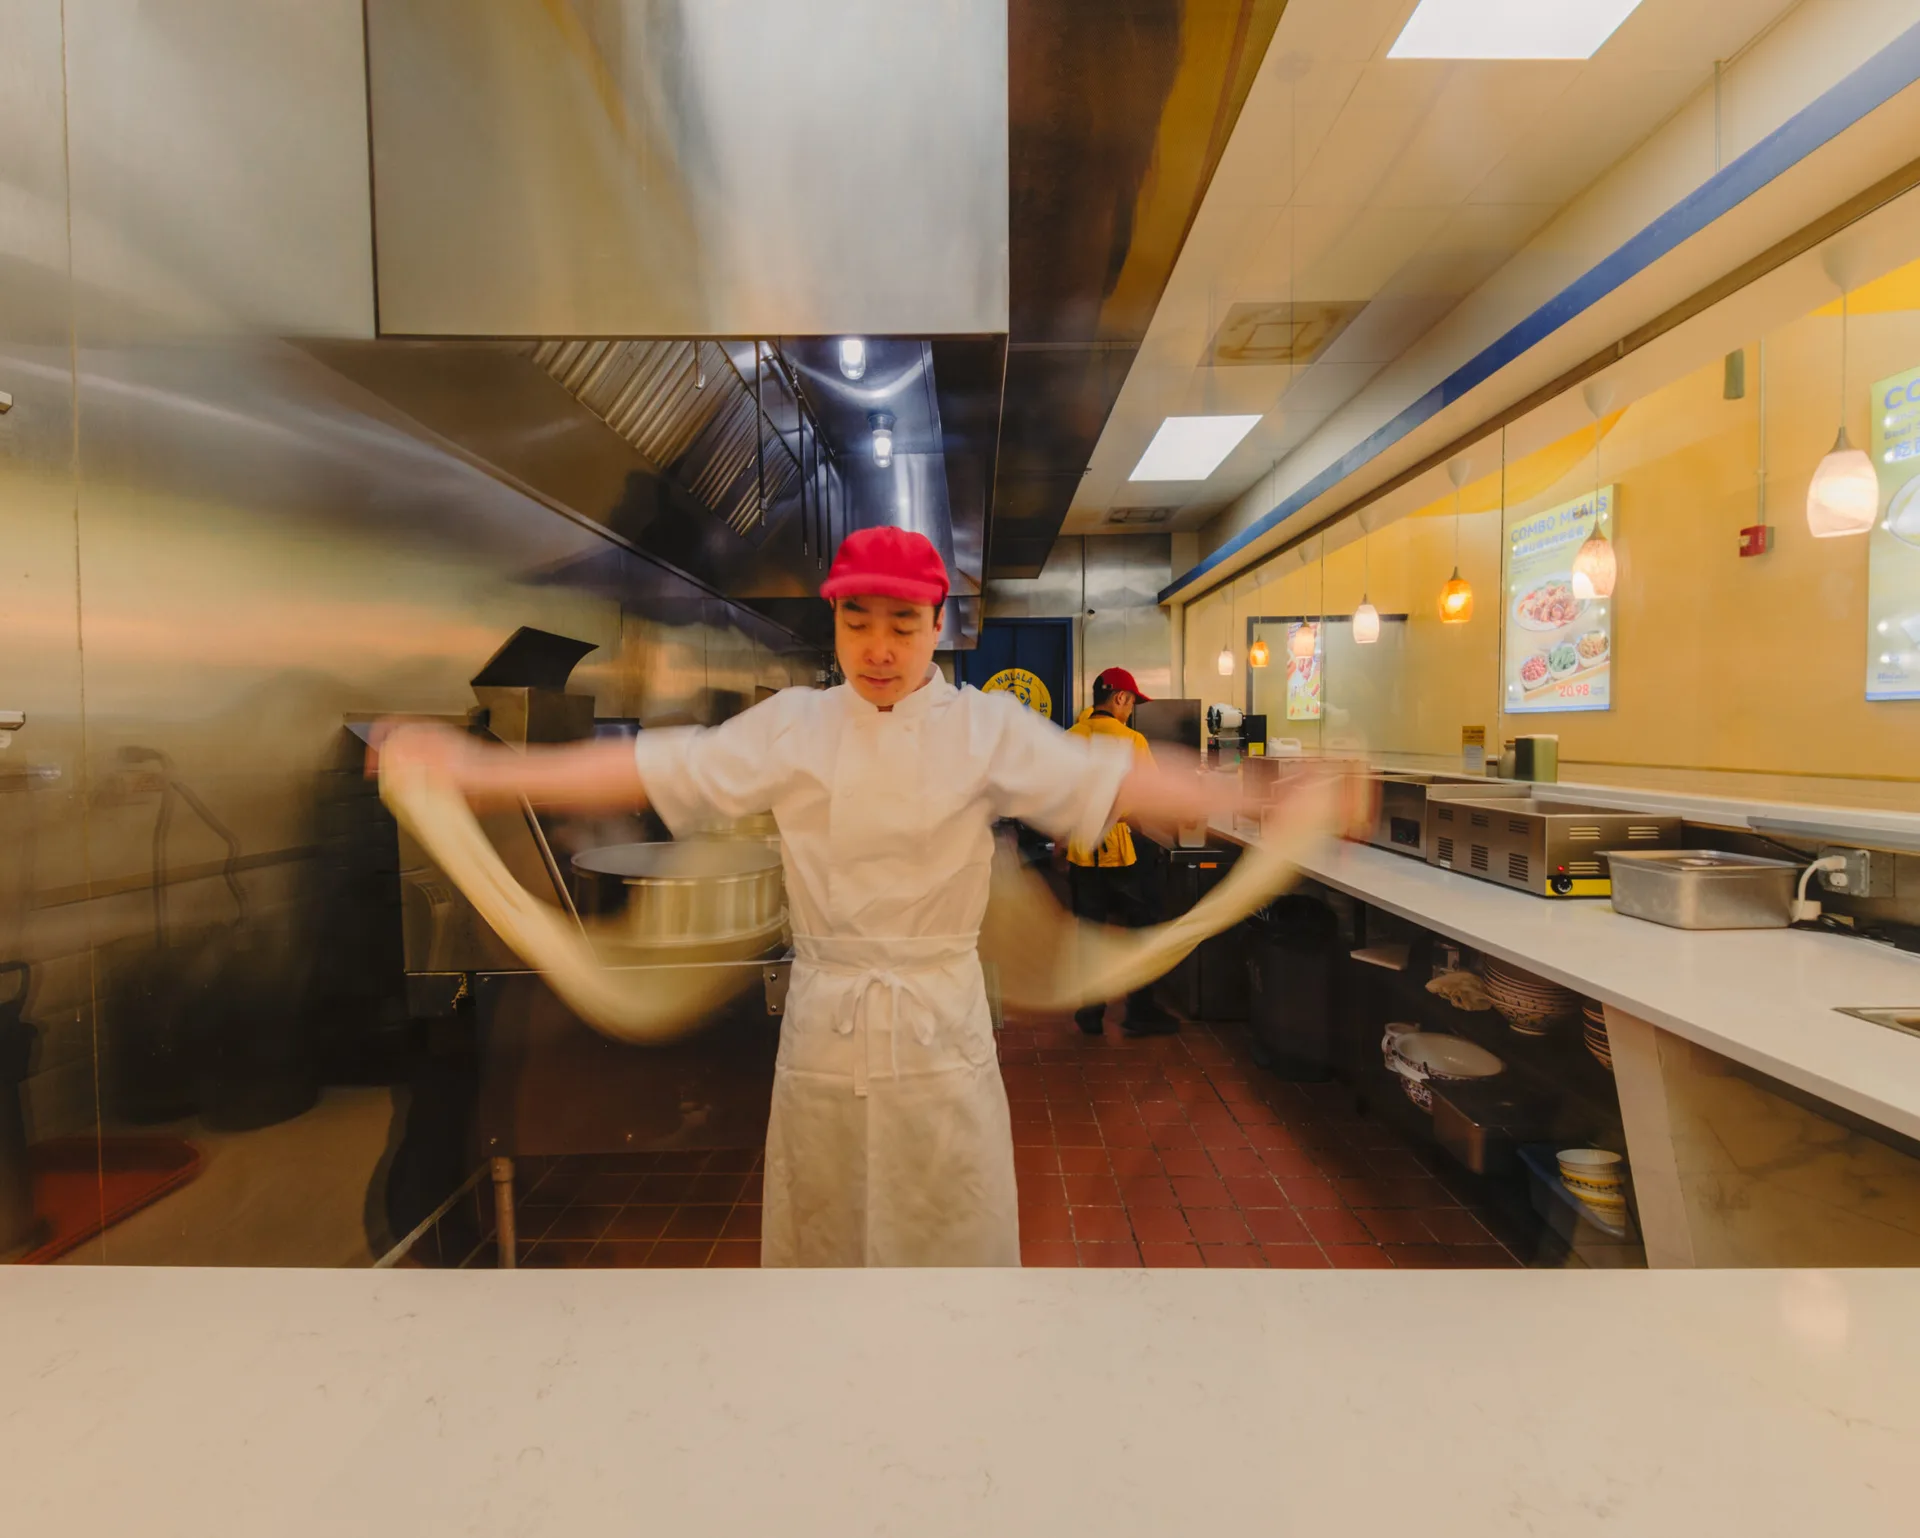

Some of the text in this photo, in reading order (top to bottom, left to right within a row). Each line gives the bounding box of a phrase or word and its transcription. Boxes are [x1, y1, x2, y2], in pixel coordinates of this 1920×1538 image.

[1511, 516, 1555, 543] COMBO
[1560, 496, 1607, 526] MEALS
[995, 672, 1032, 685] WALALA
